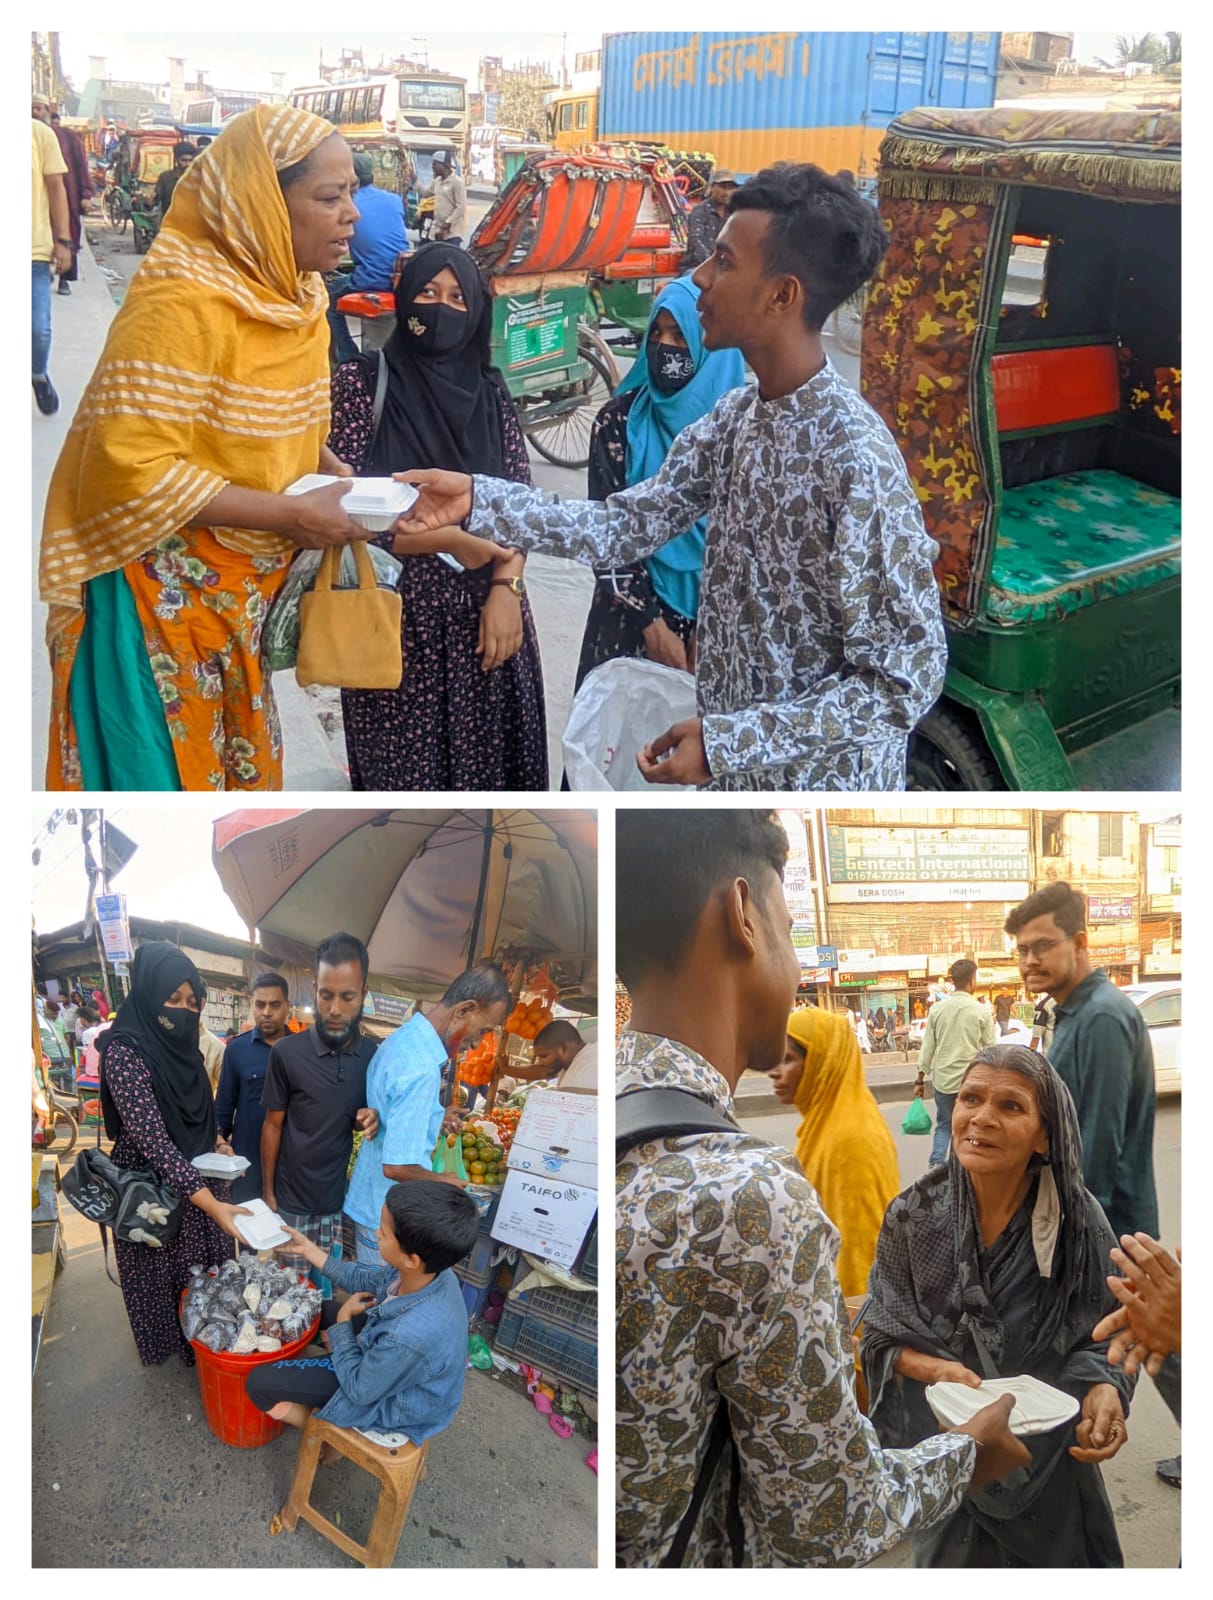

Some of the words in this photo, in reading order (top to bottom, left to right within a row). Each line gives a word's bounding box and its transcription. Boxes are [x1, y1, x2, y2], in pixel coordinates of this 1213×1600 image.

[846, 857, 916, 870] Gentech
[920, 857, 1028, 870] International
[858, 889, 880, 897] SERA
[882, 889, 905, 897] DOSH
[70, 1184, 100, 1208] it's
[521, 1182, 563, 1200] TAIFO
